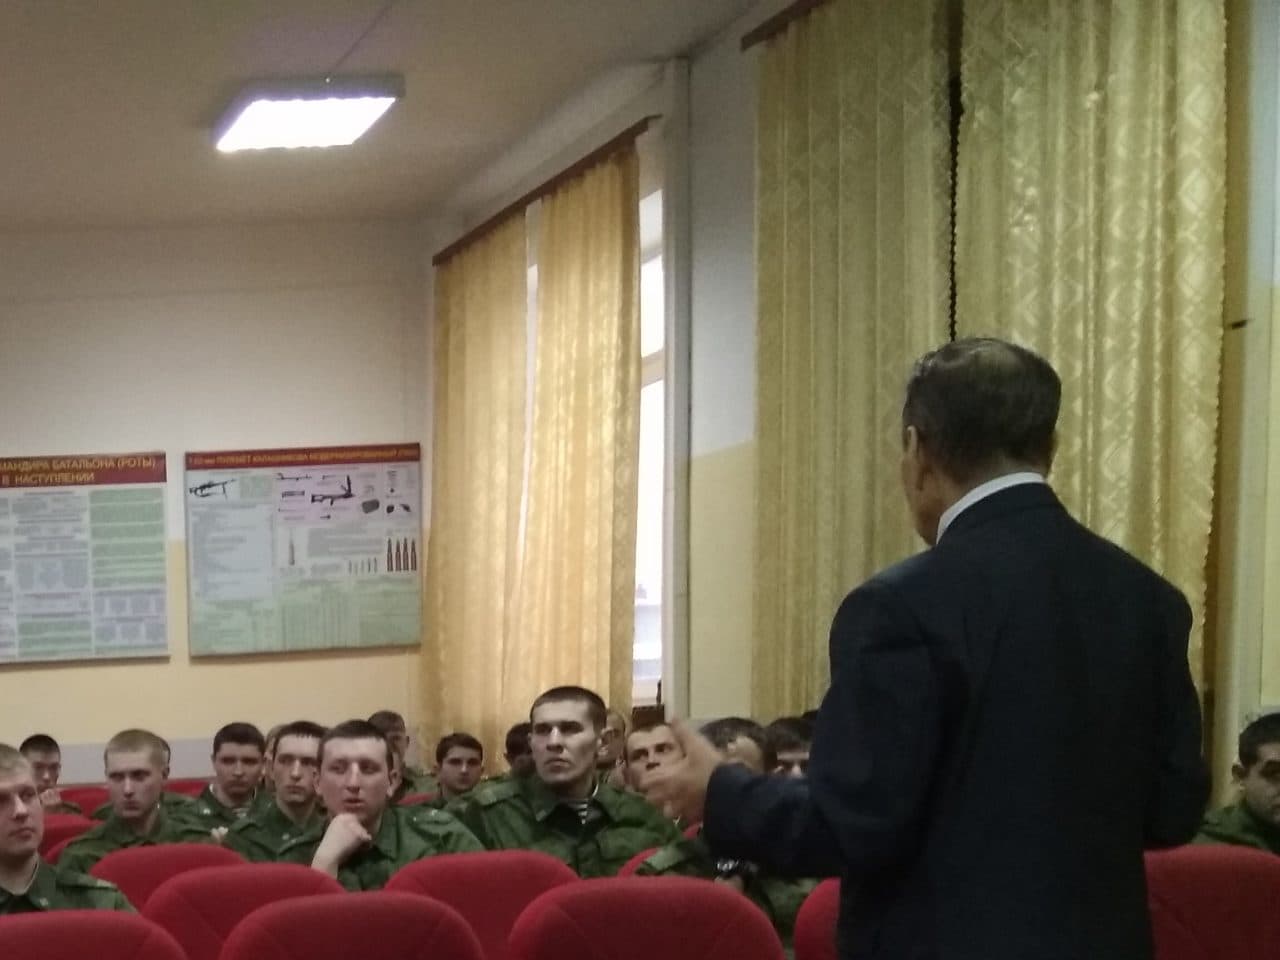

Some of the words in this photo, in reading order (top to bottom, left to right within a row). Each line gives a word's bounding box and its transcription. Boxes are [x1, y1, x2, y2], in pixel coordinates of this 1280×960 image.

[52, 458, 116, 470] БАТАЛЬОНА
[117, 456, 156, 469] (РОТЫ)
[15, 472, 95, 485] НАСТУПЛЕНИИ
